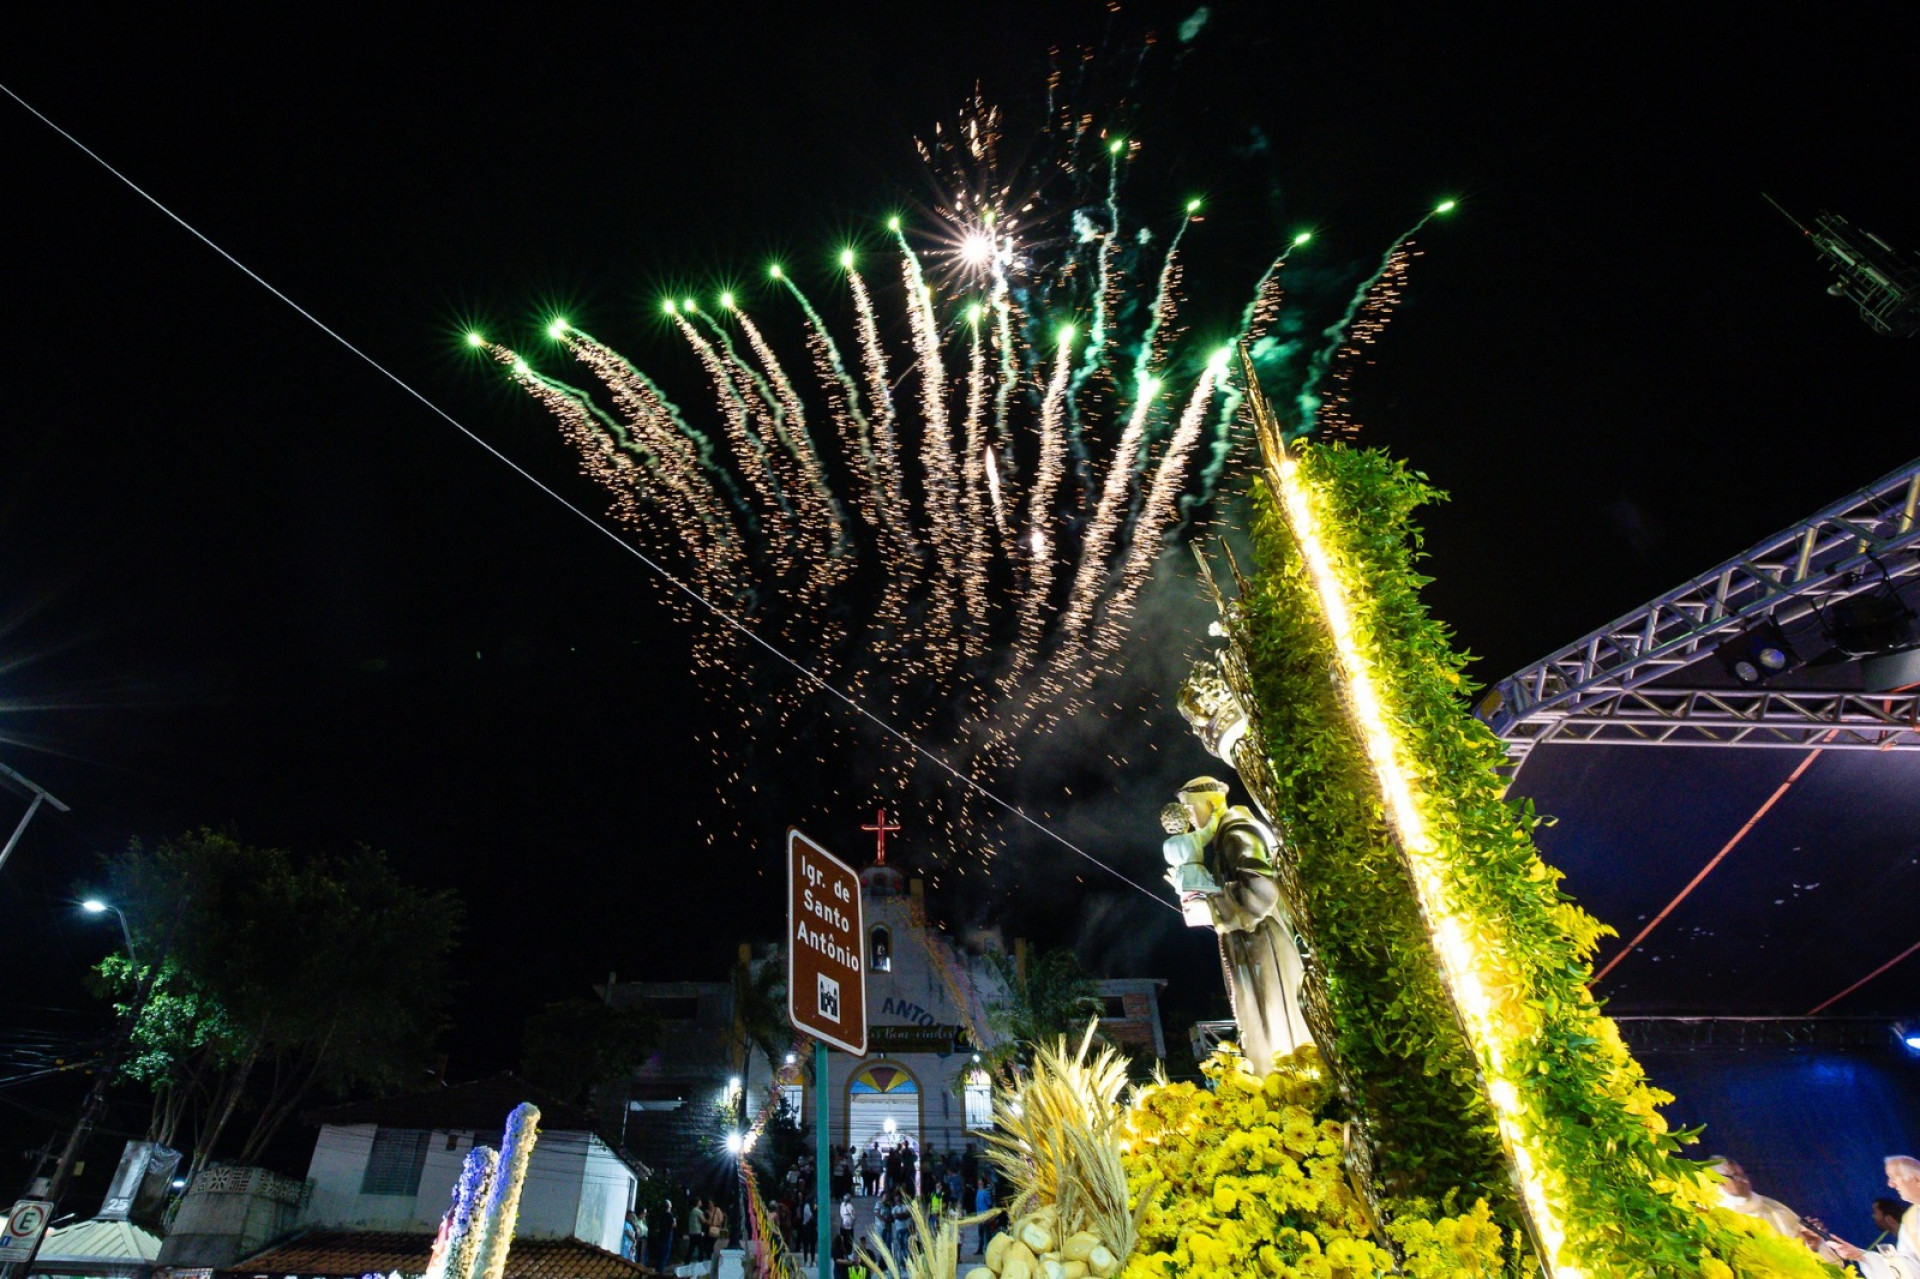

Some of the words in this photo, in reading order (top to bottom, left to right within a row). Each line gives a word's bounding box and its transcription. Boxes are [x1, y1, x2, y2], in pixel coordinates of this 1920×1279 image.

[801, 854, 827, 888] Igr.
[833, 879, 851, 904] de
[803, 888, 850, 934] Santo
[796, 919, 860, 973] Antônio
[881, 997, 940, 1028] ANTO
[18, 1212, 36, 1230] E
[107, 1198, 128, 1211] 25
